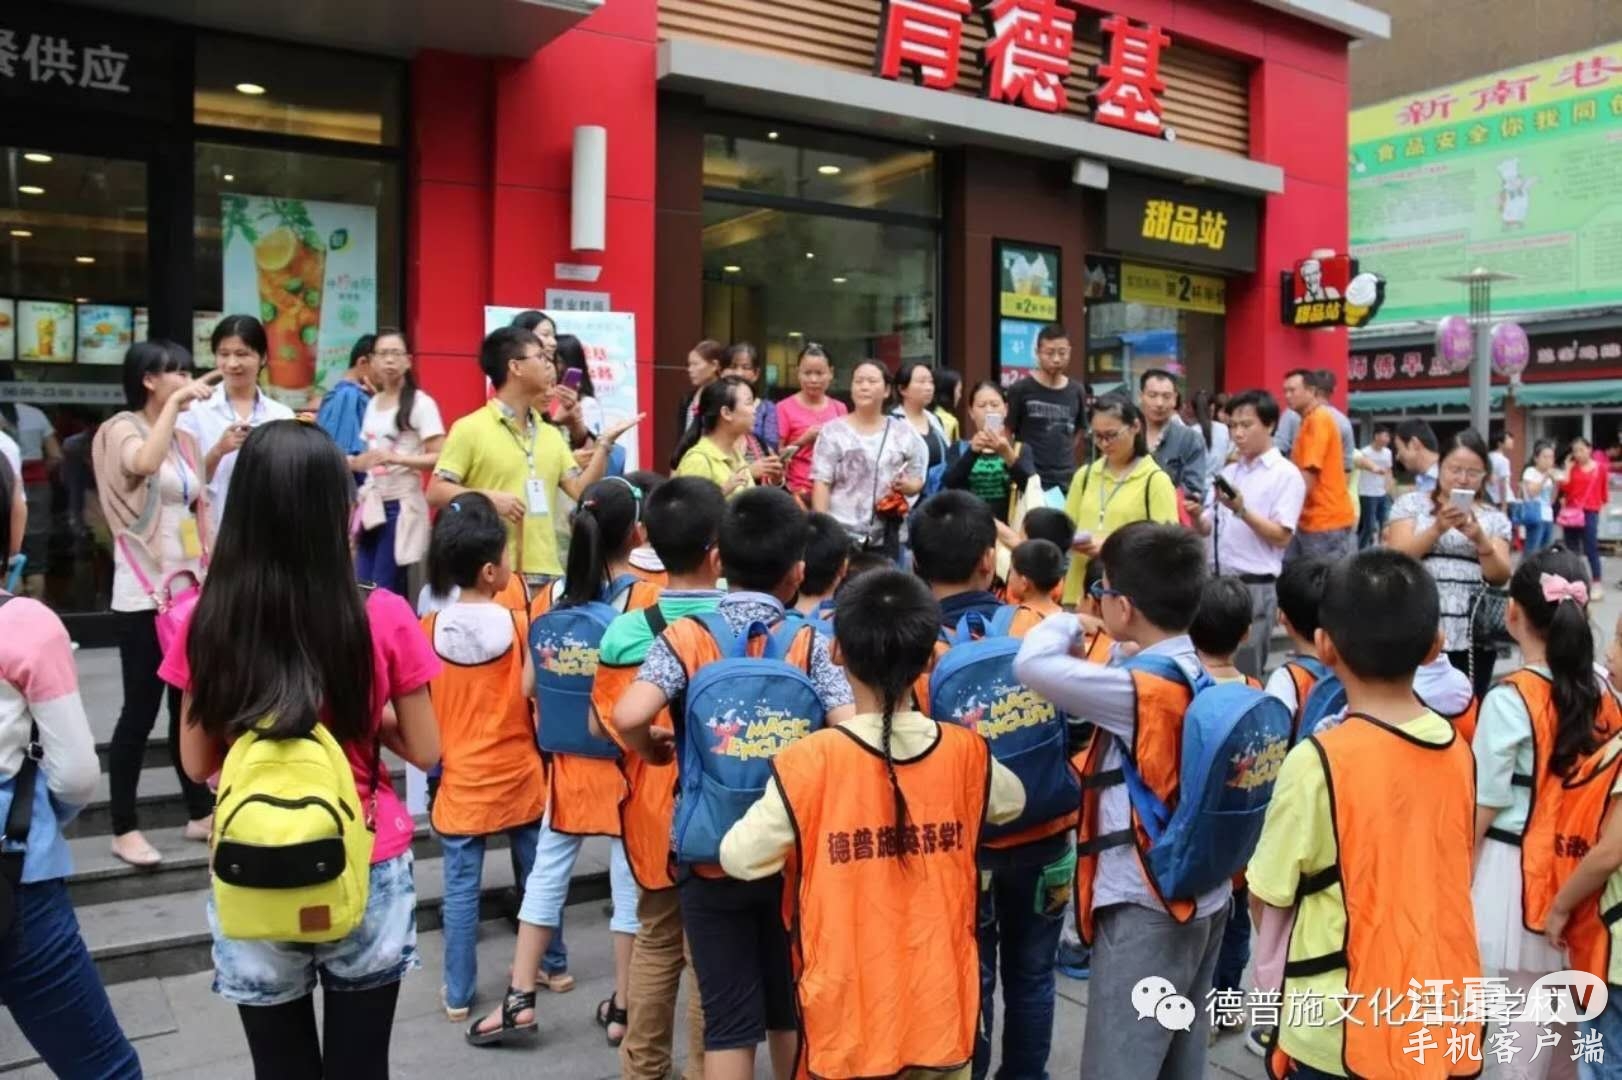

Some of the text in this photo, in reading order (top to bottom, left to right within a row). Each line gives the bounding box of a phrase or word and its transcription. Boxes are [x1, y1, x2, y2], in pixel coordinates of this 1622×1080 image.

[881, 0, 1171, 138] 肯德基
[1142, 199, 1228, 250] 甜品站
[746, 717, 811, 740] MAGIC
